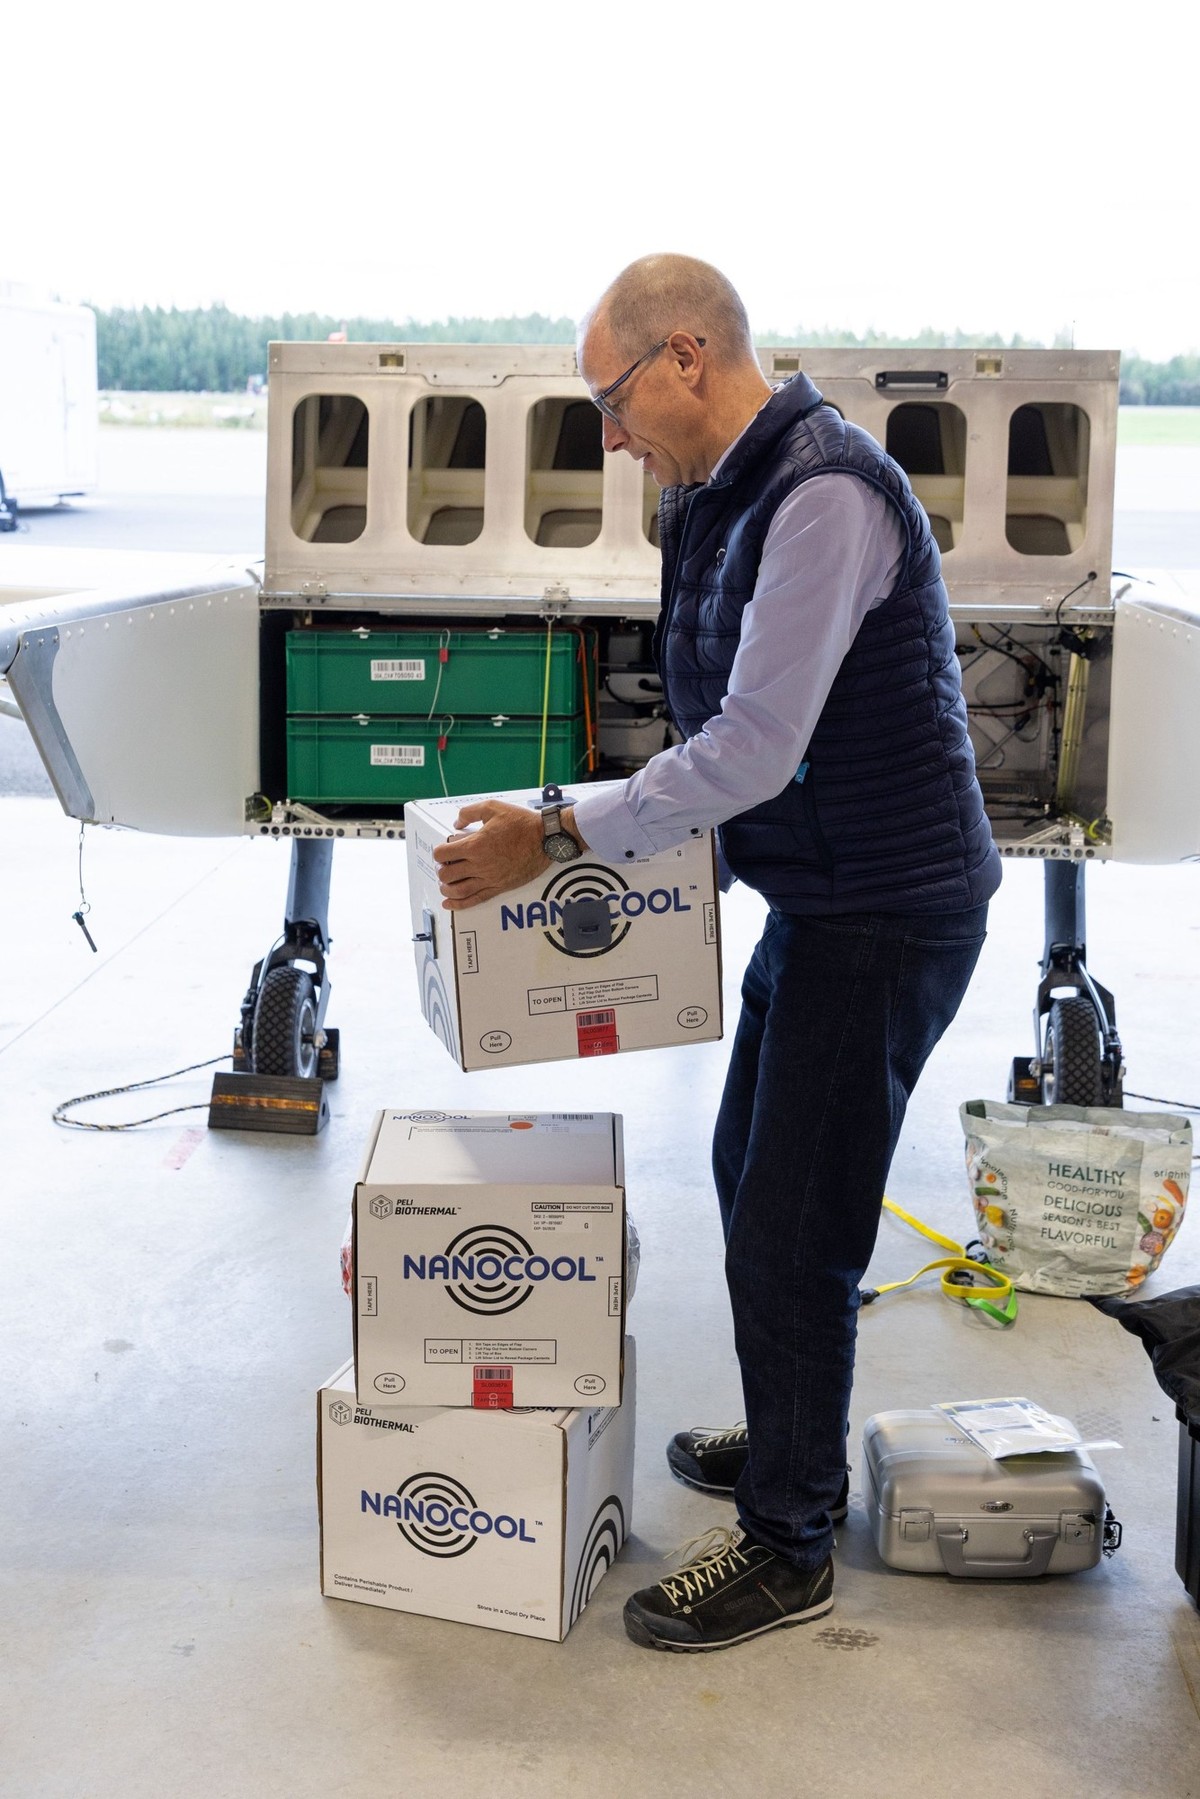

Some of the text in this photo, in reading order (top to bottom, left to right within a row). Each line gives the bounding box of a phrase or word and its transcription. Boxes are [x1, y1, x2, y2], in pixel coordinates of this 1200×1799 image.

[500, 887, 691, 930] NANCOOL
[1049, 1163, 1125, 1186] HEALTHY
[1047, 1181, 1124, 1199] GOOD-FOR-YOU
[395, 1207, 457, 1215] BIOTHERMAL
[1044, 1195, 1123, 1217] DELICIOUS
[1042, 1212, 1120, 1231] SEASON'S BEST
[1041, 1227, 1117, 1248] FLAVORFUL
[404, 1255, 596, 1281] NANOCOOL
[356, 1408, 372, 1416] PELI
[354, 1415, 414, 1433] BIOTHERMAL
[361, 1490, 536, 1543] NANOCOOL
[334, 1574, 358, 1583] Contains
[359, 1578, 388, 1588] Perishable
[388, 1584, 410, 1592] Product
[724, 1592, 760, 1611] DOLOMITE
